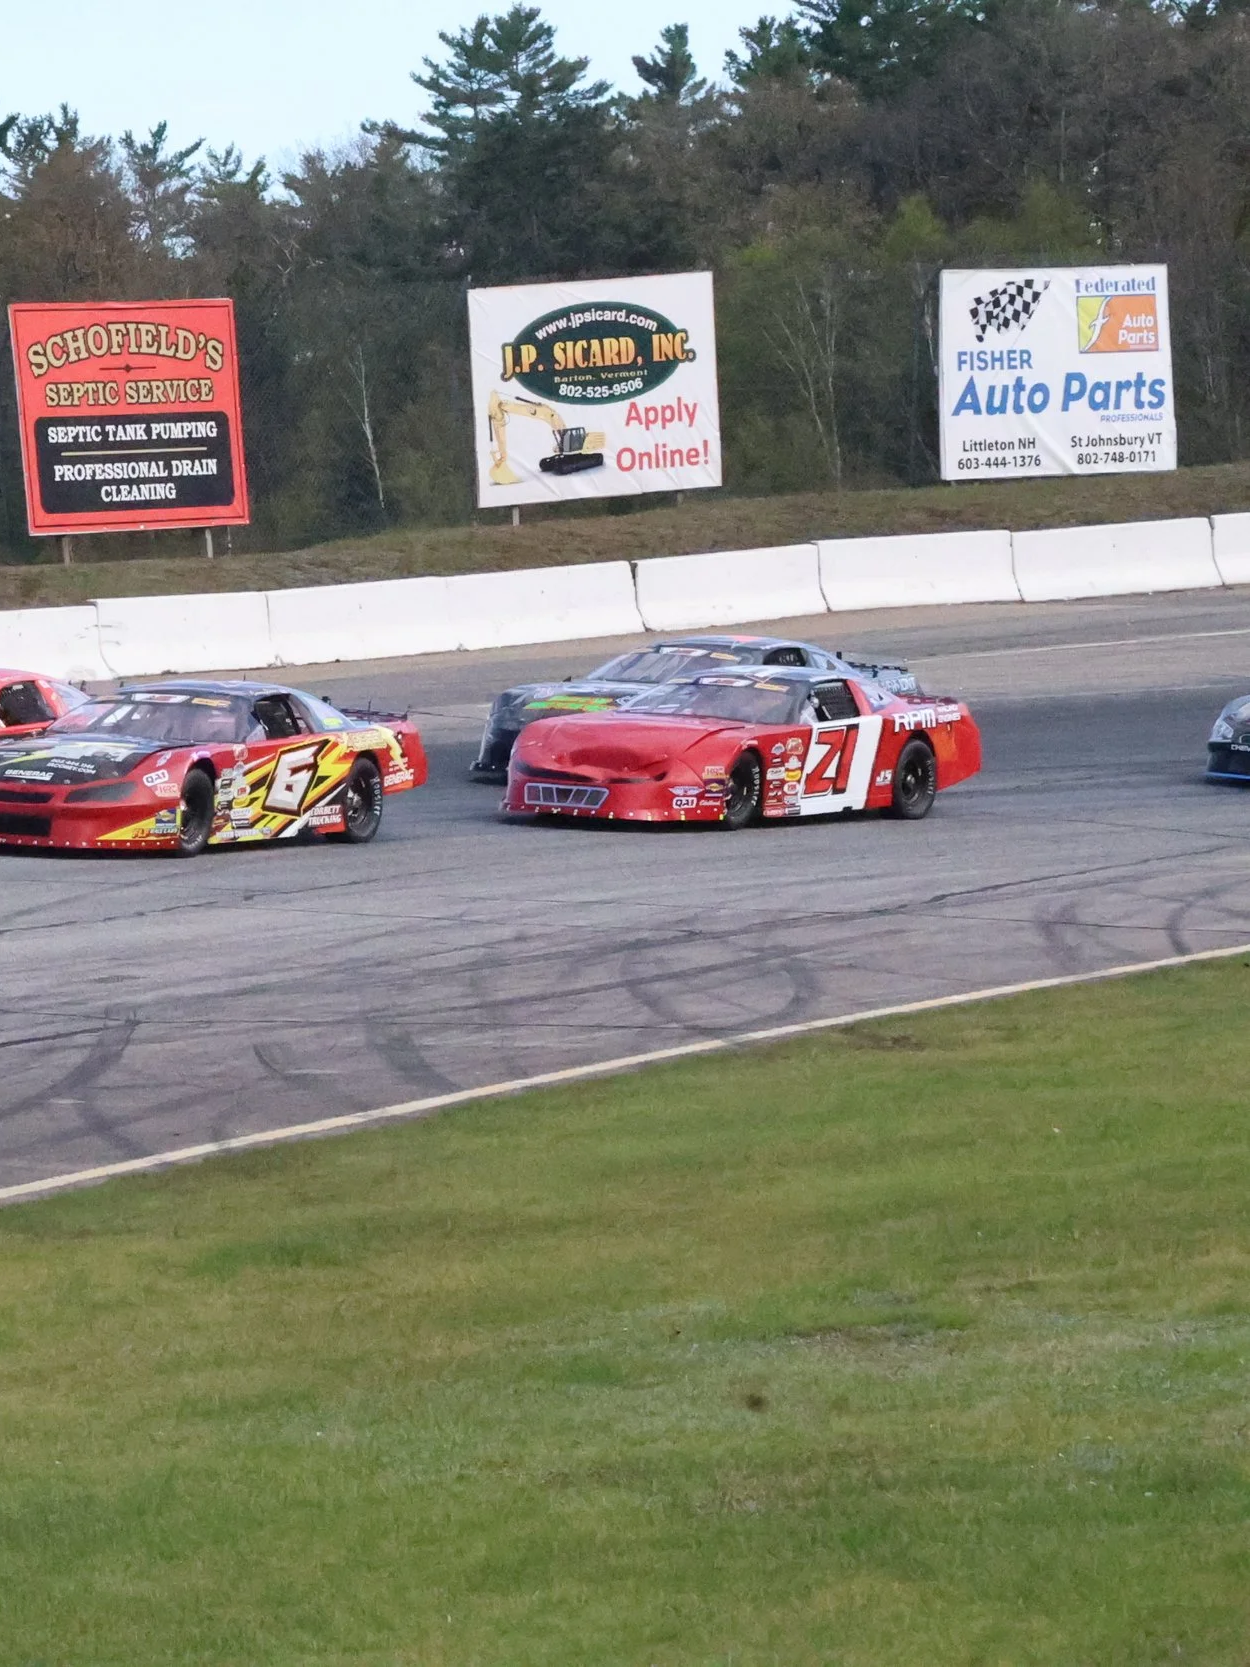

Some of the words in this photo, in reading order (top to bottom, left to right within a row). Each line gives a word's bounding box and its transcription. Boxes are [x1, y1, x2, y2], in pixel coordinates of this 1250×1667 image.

[1075, 276, 1156, 294] Federated
[535, 308, 658, 341] www.jpsicard.com
[1122, 313, 1154, 328] Auto
[1118, 329, 1155, 345] Parts
[27, 321, 224, 378] SCHOFIELD'S
[503, 343, 544, 379] J.P.
[553, 337, 644, 371] SICARD,
[652, 332, 694, 362] INC.
[957, 349, 1033, 372] FISHER
[45, 382, 119, 407] SEPTIC
[125, 378, 214, 405] SERVICE
[558, 378, 644, 398] 802-525-9506
[951, 375, 1050, 417] Auto
[1061, 372, 1166, 413] Parts
[625, 396, 698, 430] Apply
[1100, 412, 1163, 423] PROFESSIONALS
[48, 425, 102, 443] SEPTIC
[105, 424, 147, 441] TANK
[151, 421, 217, 440] PUMPING
[1071, 435, 1083, 448] St
[1085, 434, 1145, 449] Johnsbury
[1147, 432, 1162, 445] VT
[616, 439, 709, 472] Online!
[962, 438, 1015, 453] Littleton
[1018, 437, 1036, 450] NH
[957, 454, 1041, 470] 603-444-1376
[1077, 450, 1156, 465] 802-748-0171
[54, 460, 168, 481] PROFESSIONAL
[172, 459, 217, 477] DRAIN
[101, 483, 176, 502] CLEANING
[893, 708, 936, 733] RPM
[263, 742, 324, 813] 6
[309, 814, 342, 827] TRUCKING
